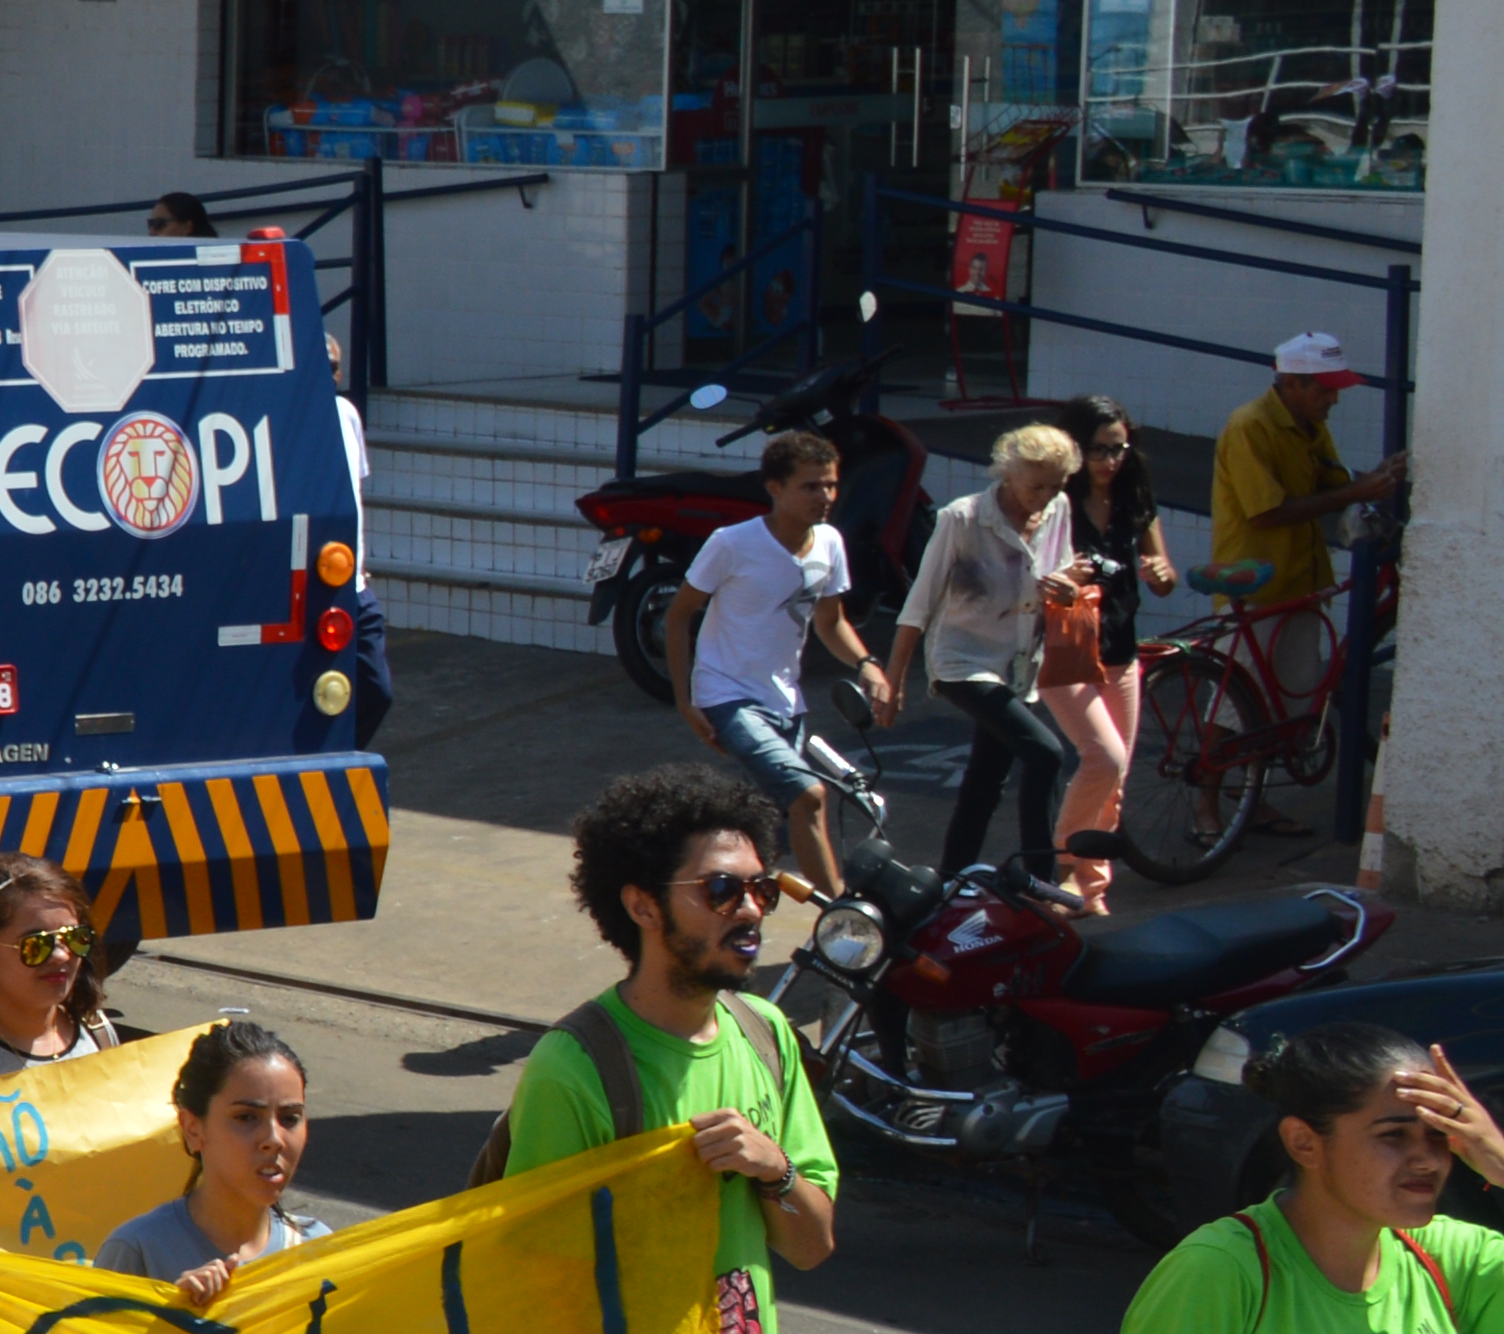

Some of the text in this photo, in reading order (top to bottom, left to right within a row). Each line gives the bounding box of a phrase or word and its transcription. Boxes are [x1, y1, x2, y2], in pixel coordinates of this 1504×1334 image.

[142, 275, 268, 295] COFRE COM DISPOSITIVO
[154, 319, 264, 337] ABERTURA NO TEMPO
[21, 574, 184, 606] 086 3232.5434
[952, 934, 1004, 954] HONDA
